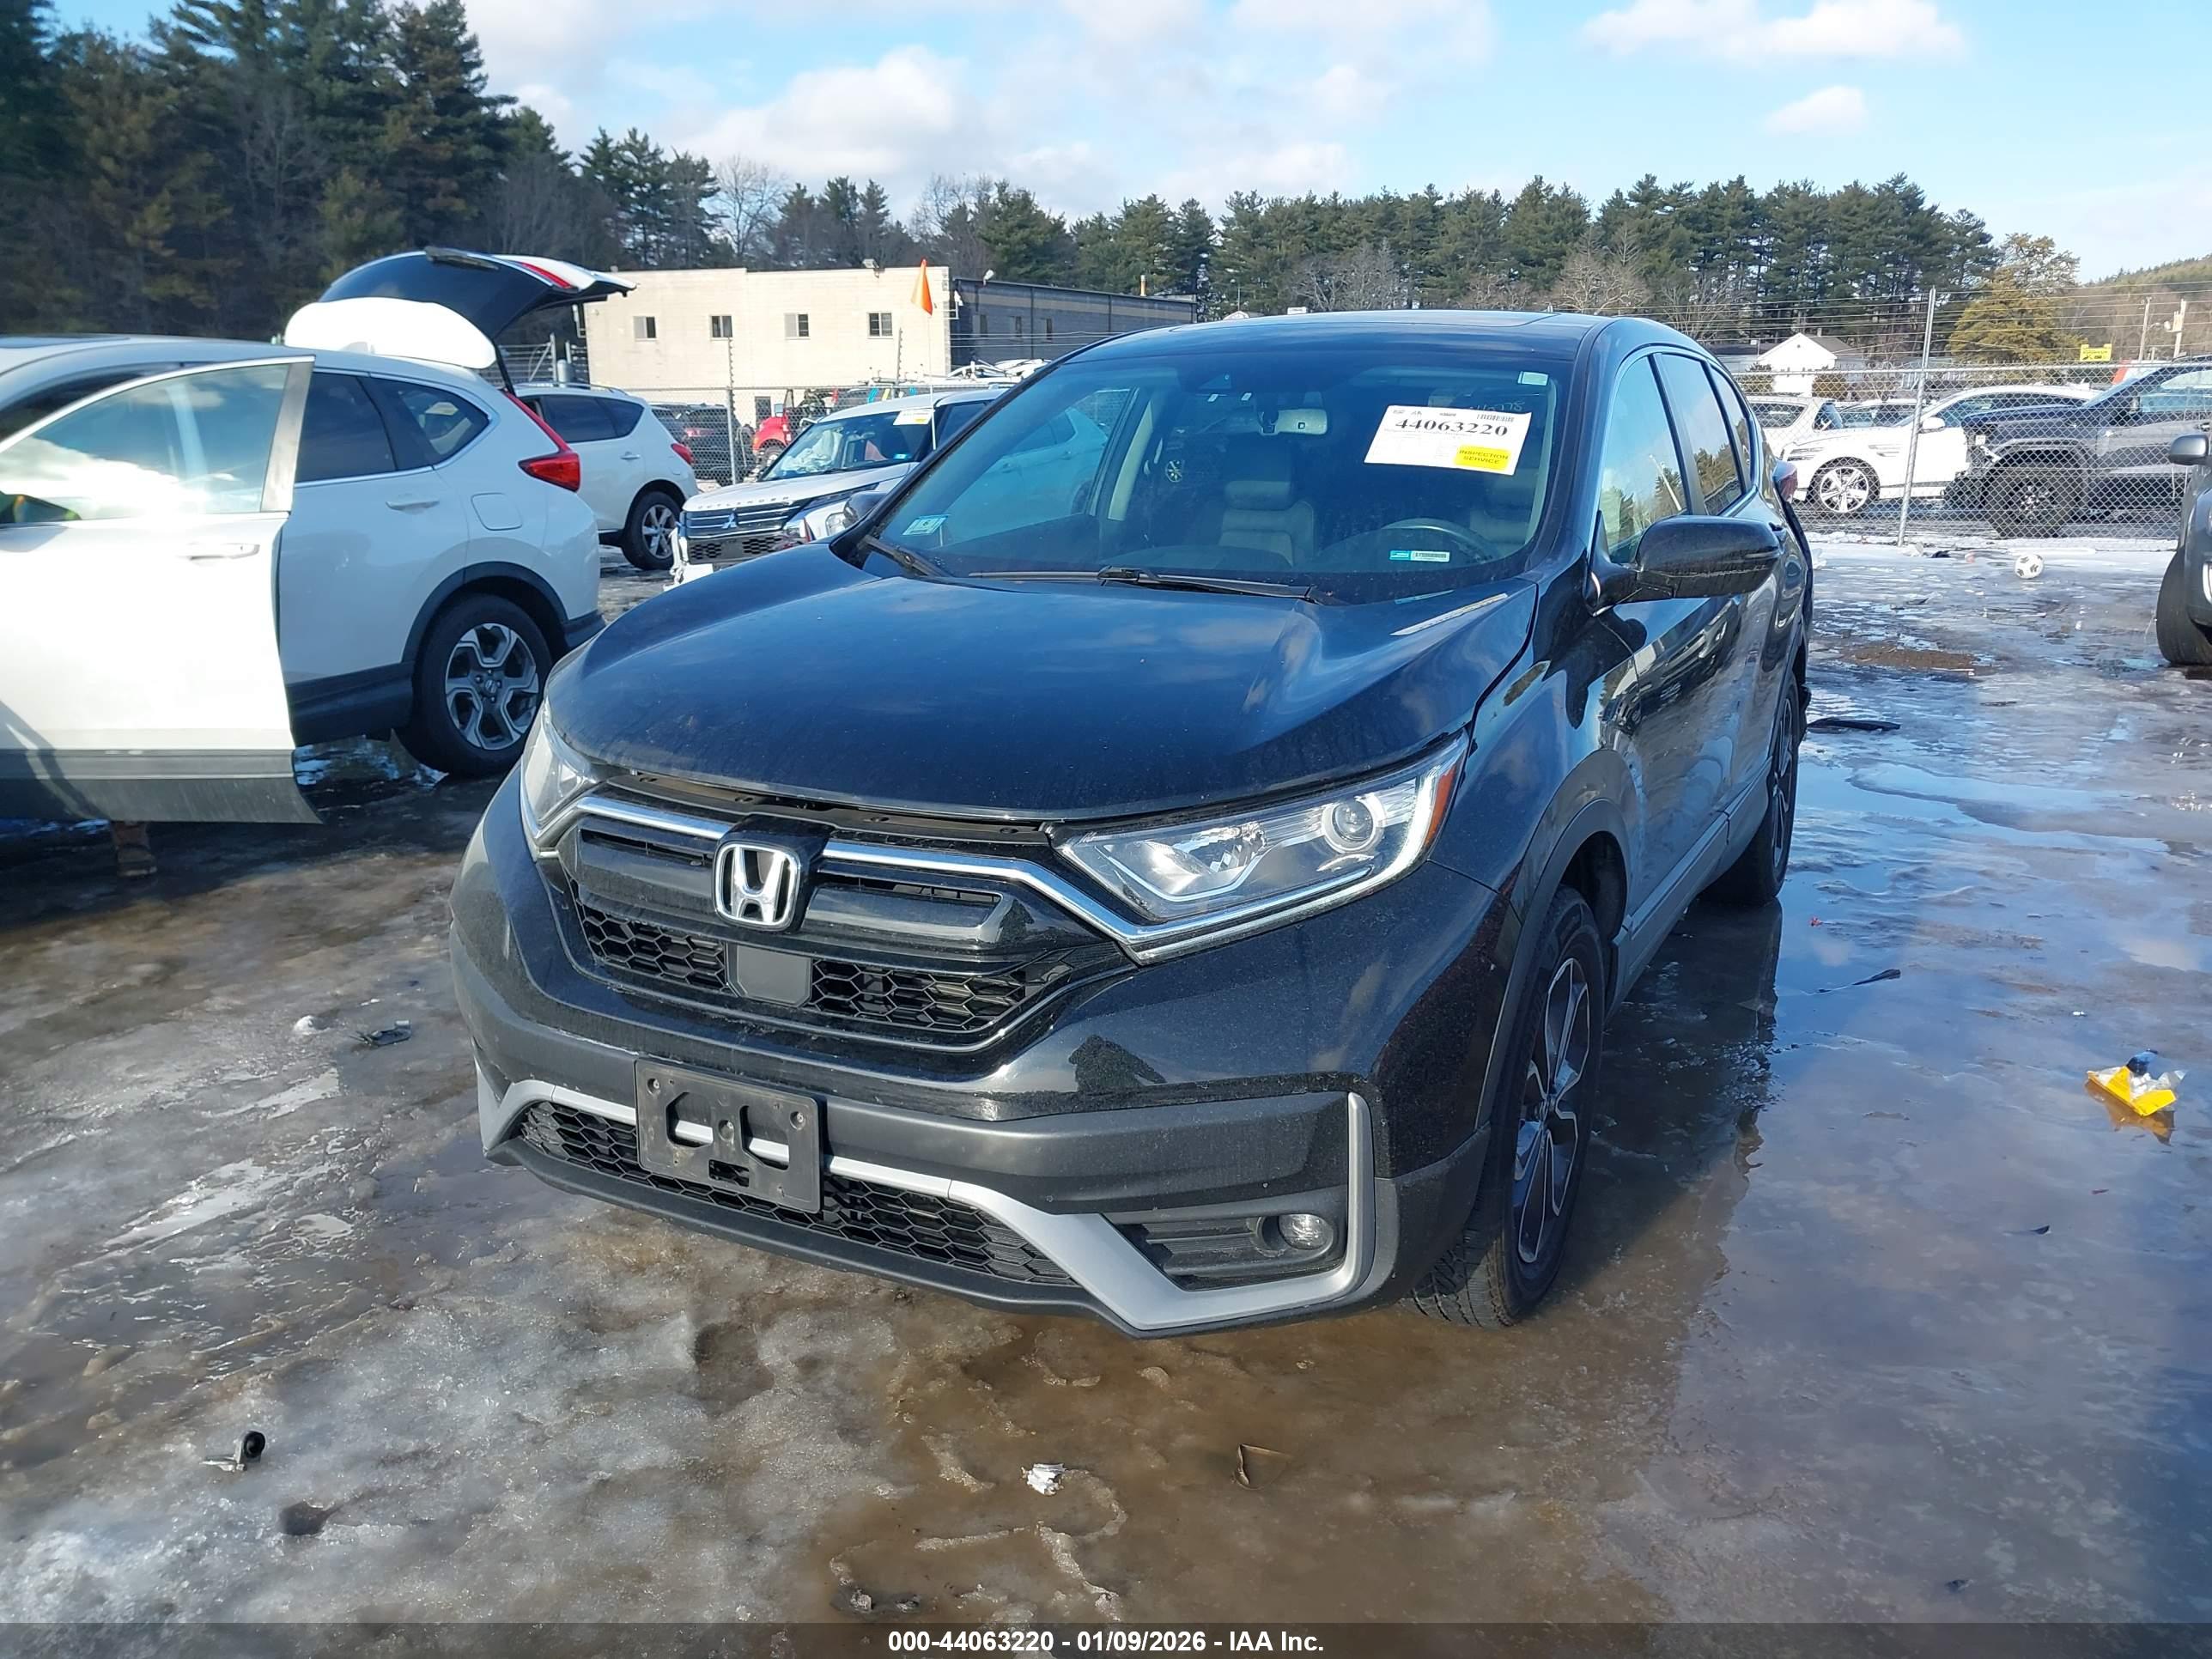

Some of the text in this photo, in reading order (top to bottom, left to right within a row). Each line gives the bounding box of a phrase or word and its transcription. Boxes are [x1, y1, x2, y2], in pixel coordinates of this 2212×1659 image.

[1395, 418, 1508, 436] 44063220
[1459, 448, 1509, 460] INSPECTION
[1463, 455, 1501, 465] SERVICE
